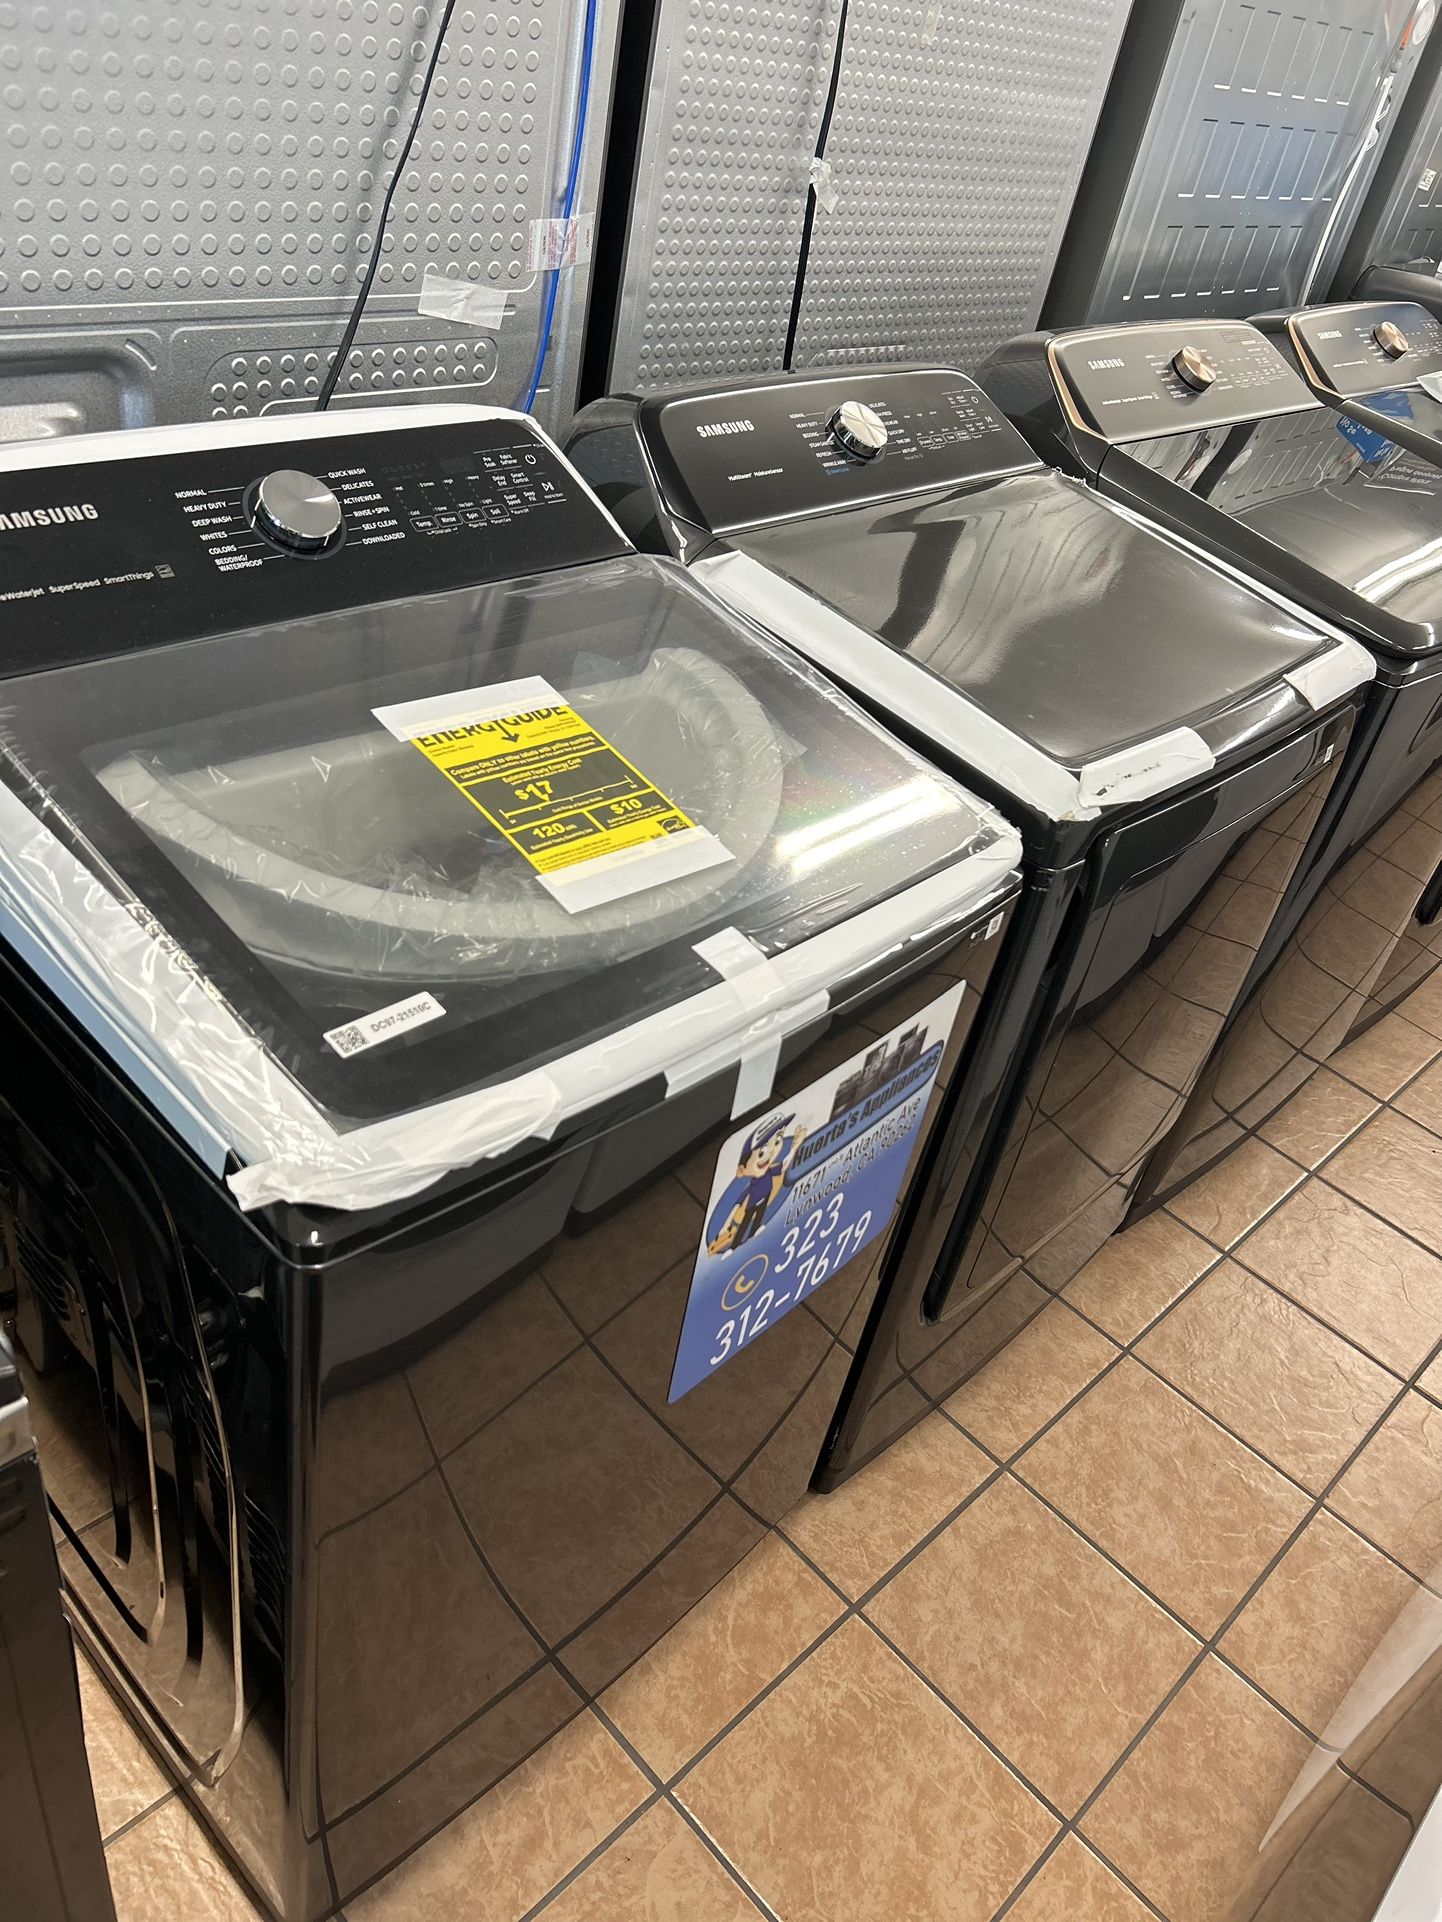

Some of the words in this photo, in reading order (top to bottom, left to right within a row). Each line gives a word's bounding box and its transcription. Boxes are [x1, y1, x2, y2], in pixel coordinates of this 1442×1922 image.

[1087, 358, 1125, 370] SAMSUNG
[696, 419, 755, 438] SAMSUNG
[327, 470, 348, 479] QUICK
[347, 467, 367, 476] WASH
[341, 480, 375, 491] DELICATES
[174, 488, 207, 499] NORMAL
[343, 493, 383, 505] ACTIVEWEAR
[183, 503, 207, 513] HEAVY
[207, 501, 227, 510] DUTY
[191, 518, 211, 527] DEEP
[210, 515, 233, 525] WASH
[466, 512, 479, 520] Spin
[361, 522, 377, 531] SELF
[376, 519, 398, 528] CLEAN
[199, 530, 228, 541] WHITES
[362, 531, 406, 545] DOWNLOADED
[208, 544, 238, 555] COLORS
[214, 554, 248, 566] BEDDING/
[218, 558, 264, 572] WATERPROOF
[49, 578, 101, 594] SuperSpeed
[104, 570, 155, 586] SmartThings
[514, 780, 553, 801] $17
[610, 798, 643, 815] $10
[532, 822, 566, 839] 120
[791, 1109, 859, 1170] Huerta's
[860, 1049, 940, 1121] Appliances
[792, 1164, 827, 1204] 11671
[843, 1117, 896, 1167] Atlantic
[897, 1096, 921, 1122] Ave
[857, 1146, 875, 1172] CA
[774, 1192, 845, 1273] 323
[710, 1209, 872, 1366] 312-7679
